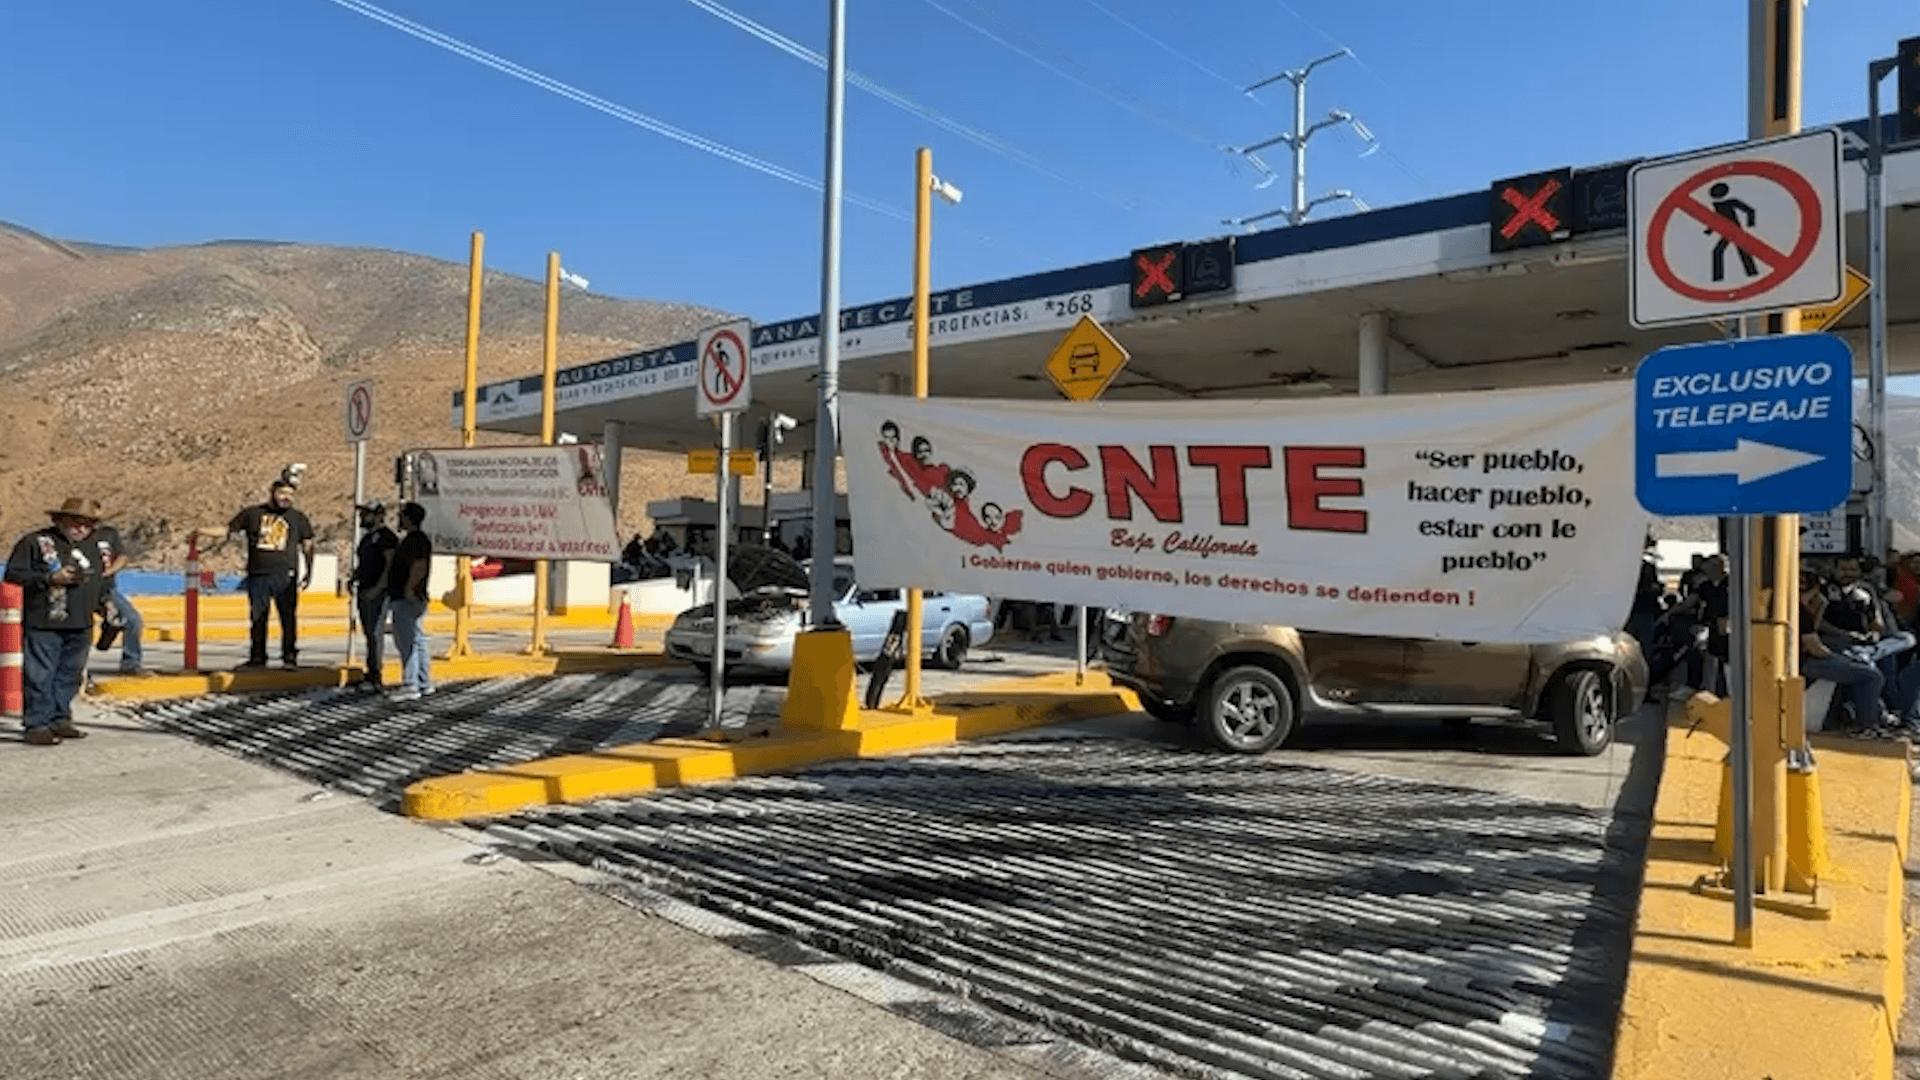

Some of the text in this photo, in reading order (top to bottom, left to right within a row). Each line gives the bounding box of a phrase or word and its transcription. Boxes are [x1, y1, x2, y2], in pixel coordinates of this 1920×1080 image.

[906, 306, 1029, 339] EERGENCIAS:
[557, 350, 678, 386] AUTOPISTA
[1652, 362, 1833, 398] EXCLUSIVO
[1653, 396, 1832, 428] TELEPEAJE
[1483, 449, 1584, 474] pueblo,
[1020, 443, 1369, 534] CNTE
[1408, 480, 1592, 509] hacer pueblo,
[1110, 528, 1259, 558] Baja California
[1419, 518, 1576, 538] estar con le
[1047, 561, 1091, 575] quien
[1185, 571, 1211, 586] los
[1218, 574, 1308, 596] derechos
[1316, 584, 1340, 598] se
[1347, 586, 1460, 605] defienden
